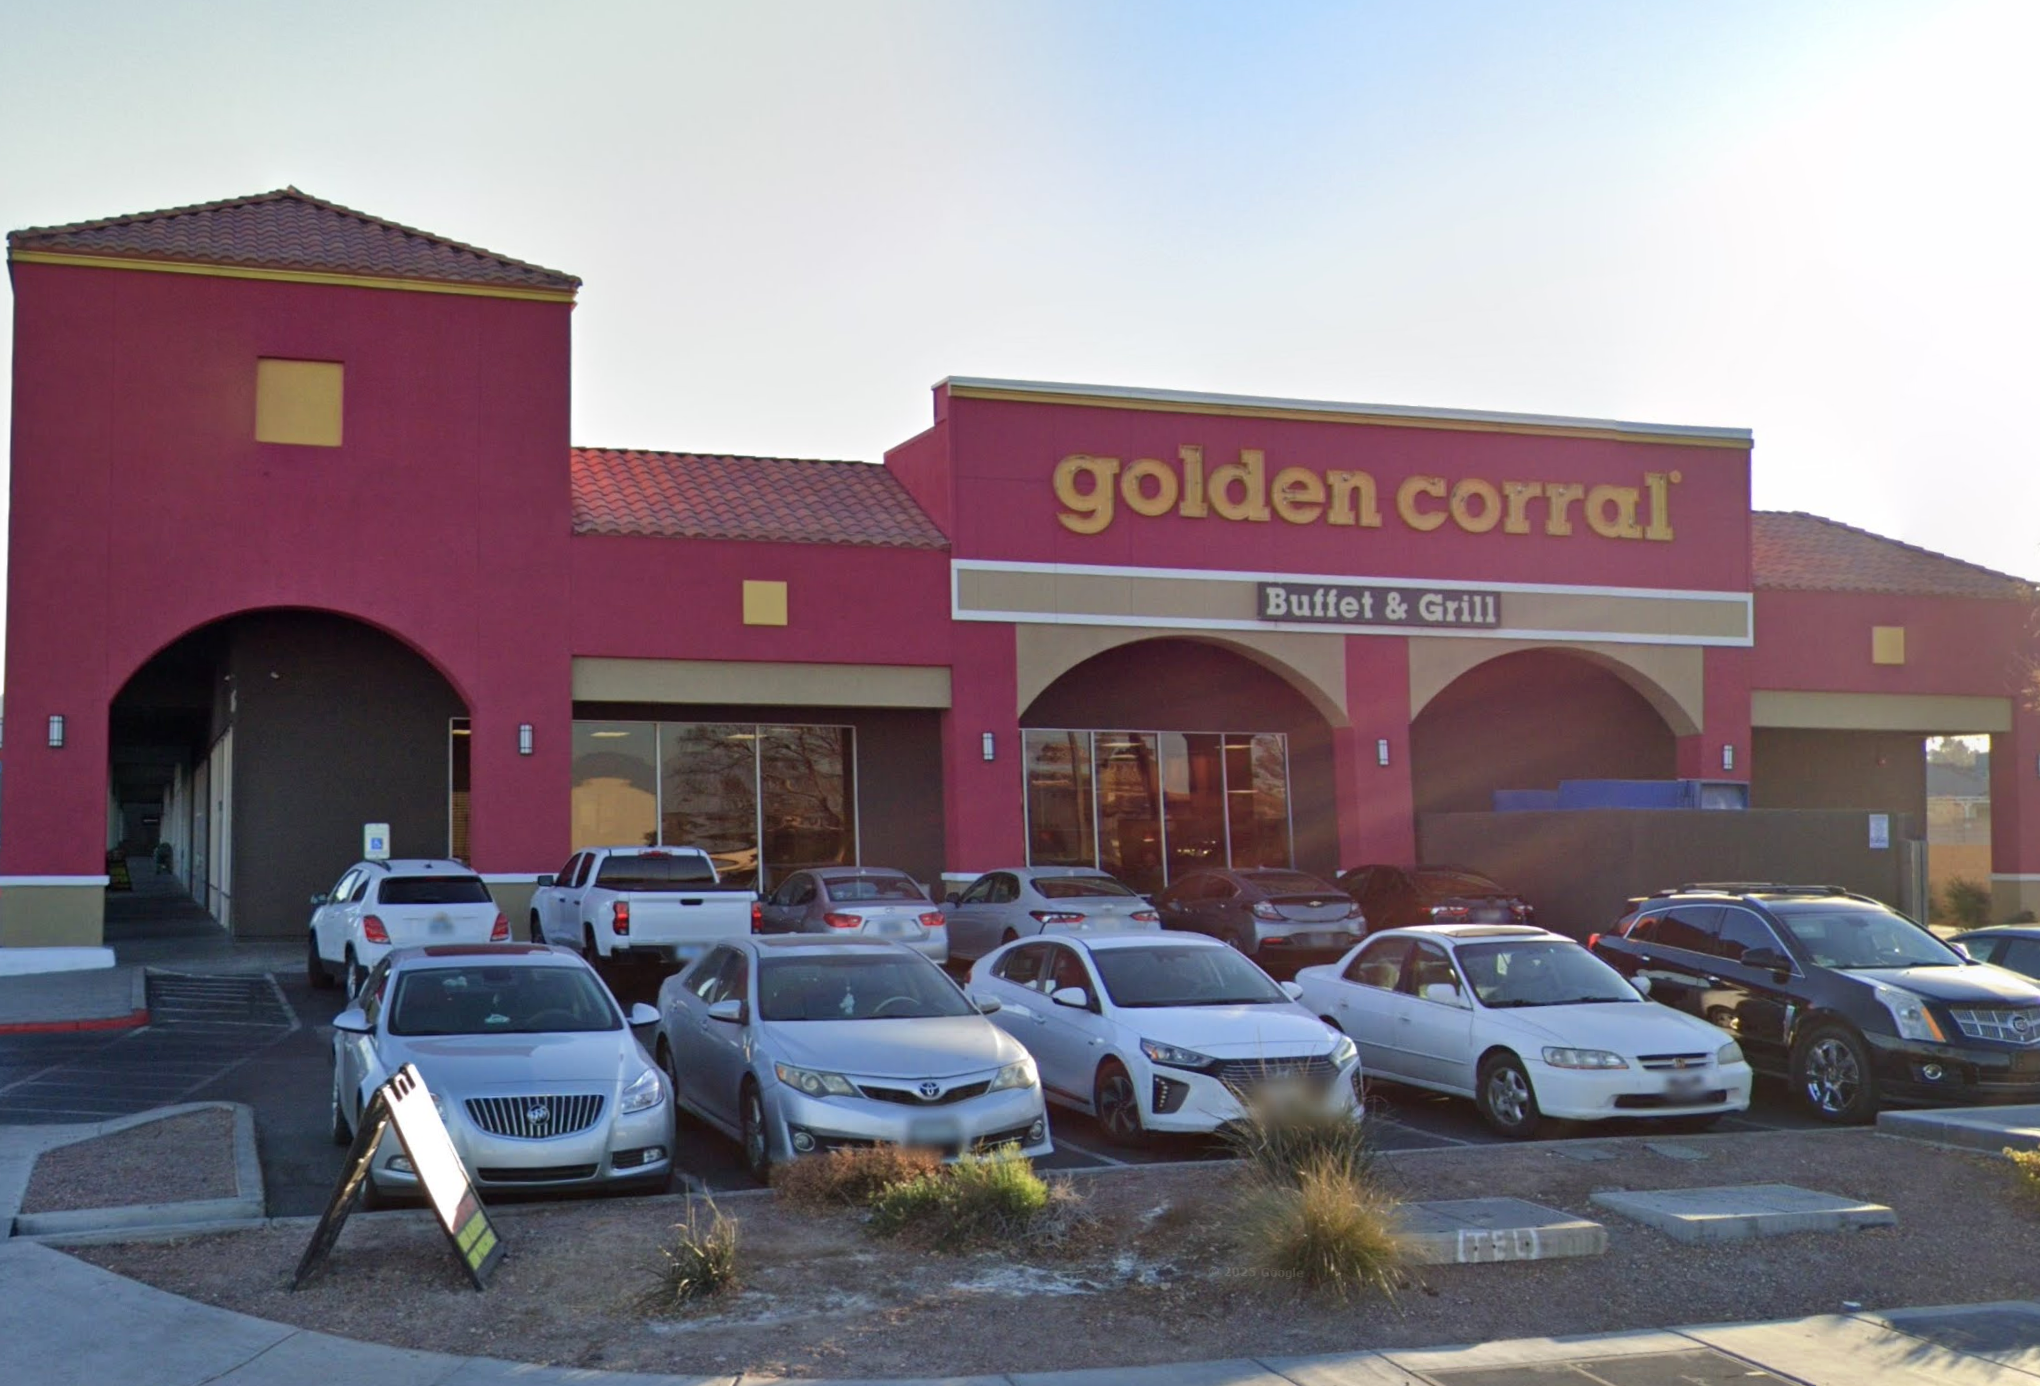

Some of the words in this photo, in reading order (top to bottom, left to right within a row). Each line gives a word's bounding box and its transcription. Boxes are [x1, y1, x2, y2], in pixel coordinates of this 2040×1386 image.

[1053, 443, 1383, 535] golden
[1396, 470, 1674, 542] corral
[1265, 586, 1374, 619] Buffet
[1384, 591, 1409, 621] &
[1418, 592, 1497, 624] Grill
